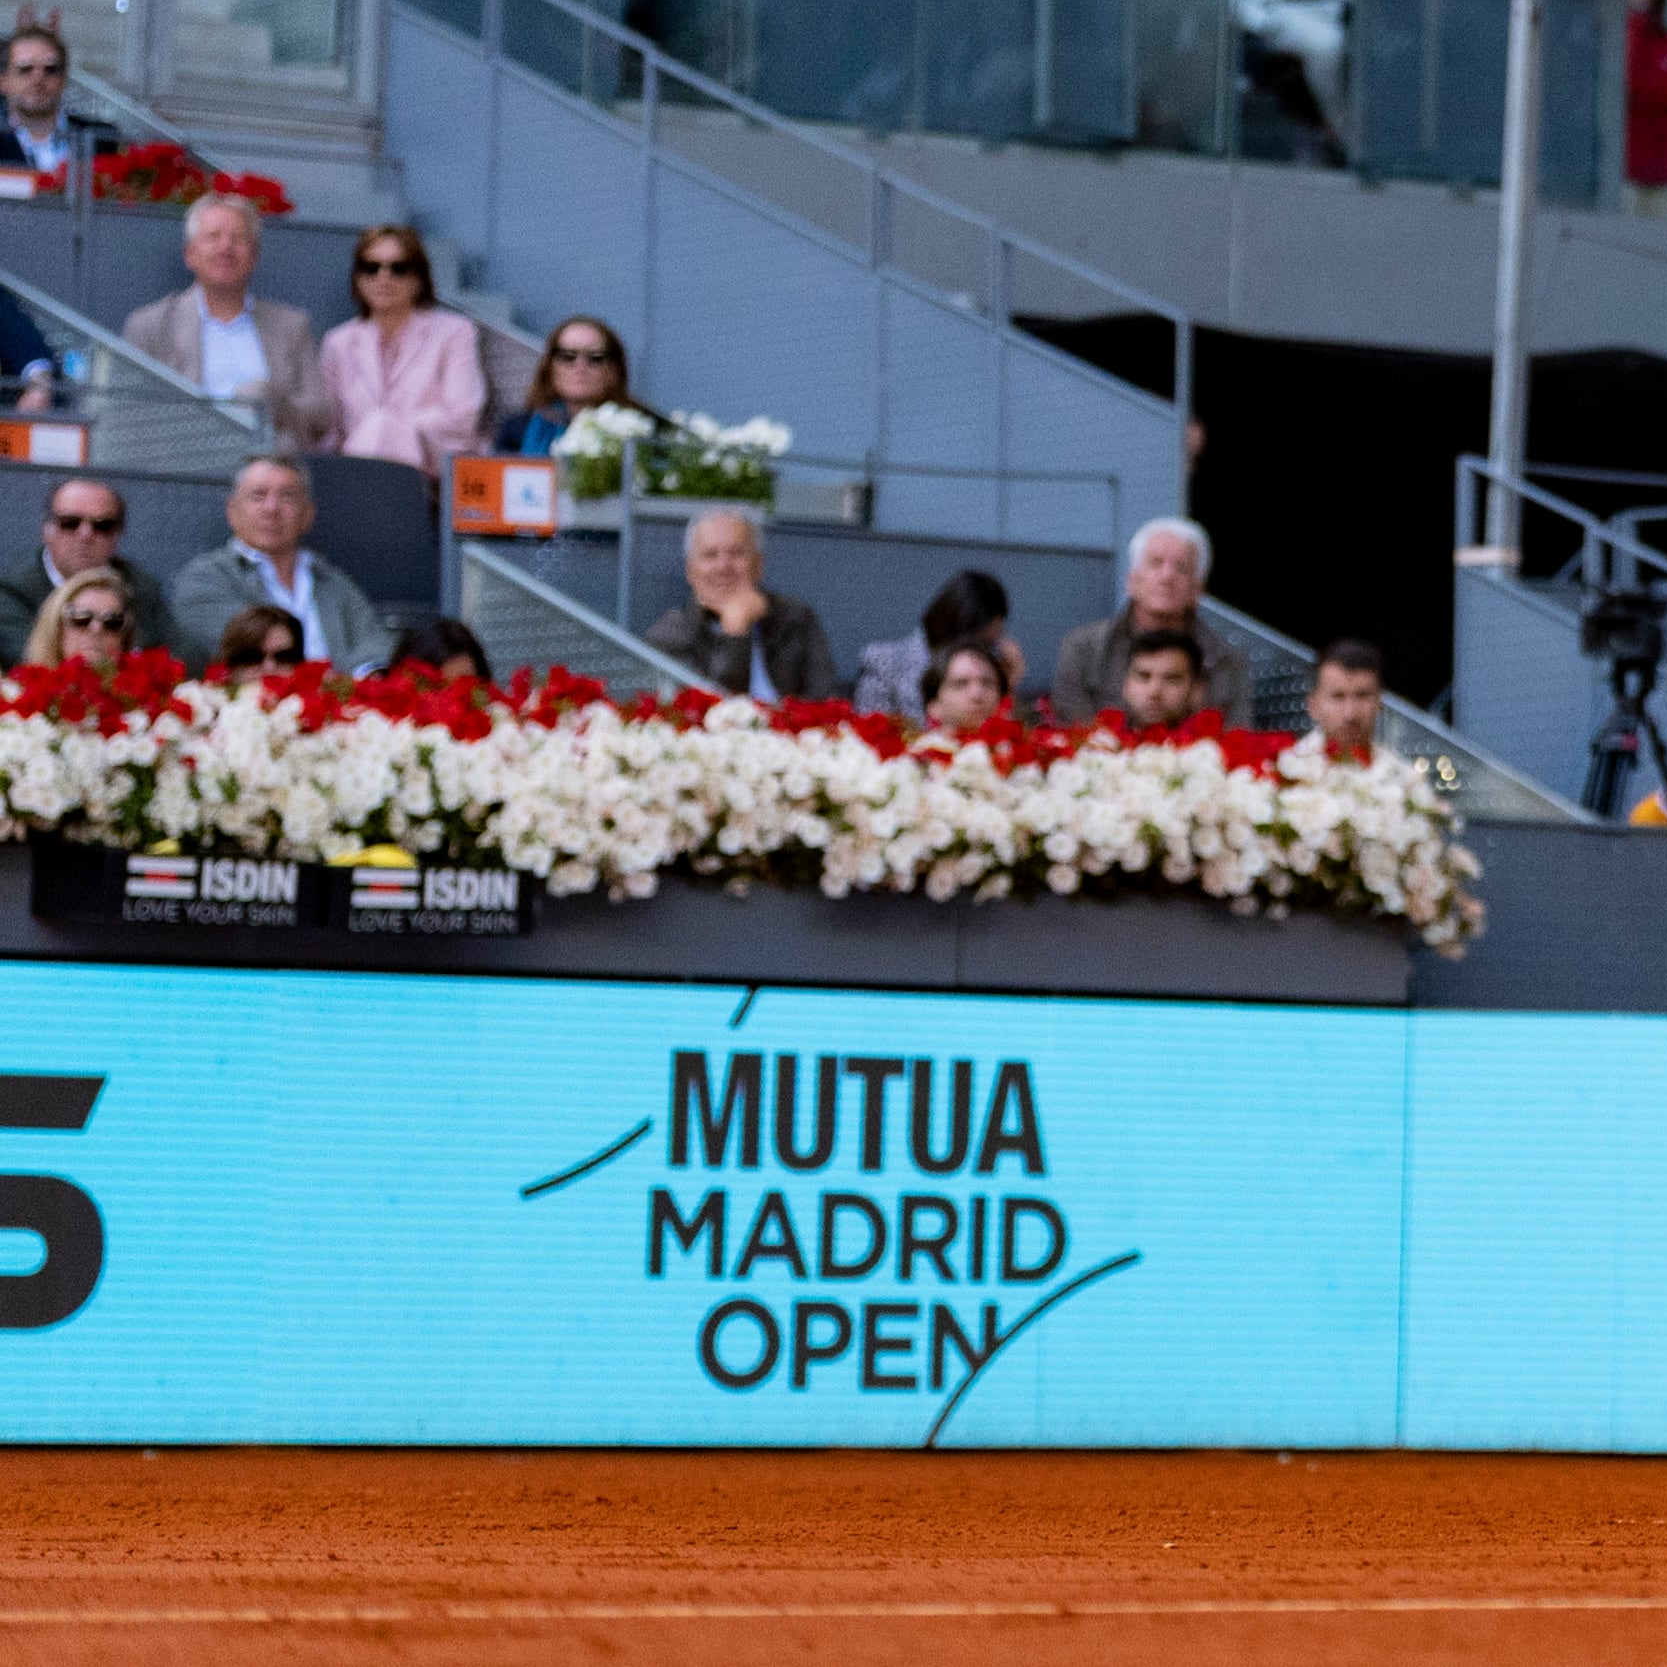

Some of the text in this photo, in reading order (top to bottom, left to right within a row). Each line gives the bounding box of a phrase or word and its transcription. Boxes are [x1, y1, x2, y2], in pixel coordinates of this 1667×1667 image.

[123, 899, 181, 924] LOVE
[201, 855, 298, 903] ISDIN
[424, 867, 519, 911] ISDIN
[669, 1050, 1047, 1175] MUTUA
[646, 1189, 1067, 1285] MADRID
[700, 1297, 1001, 1392] OPEN
